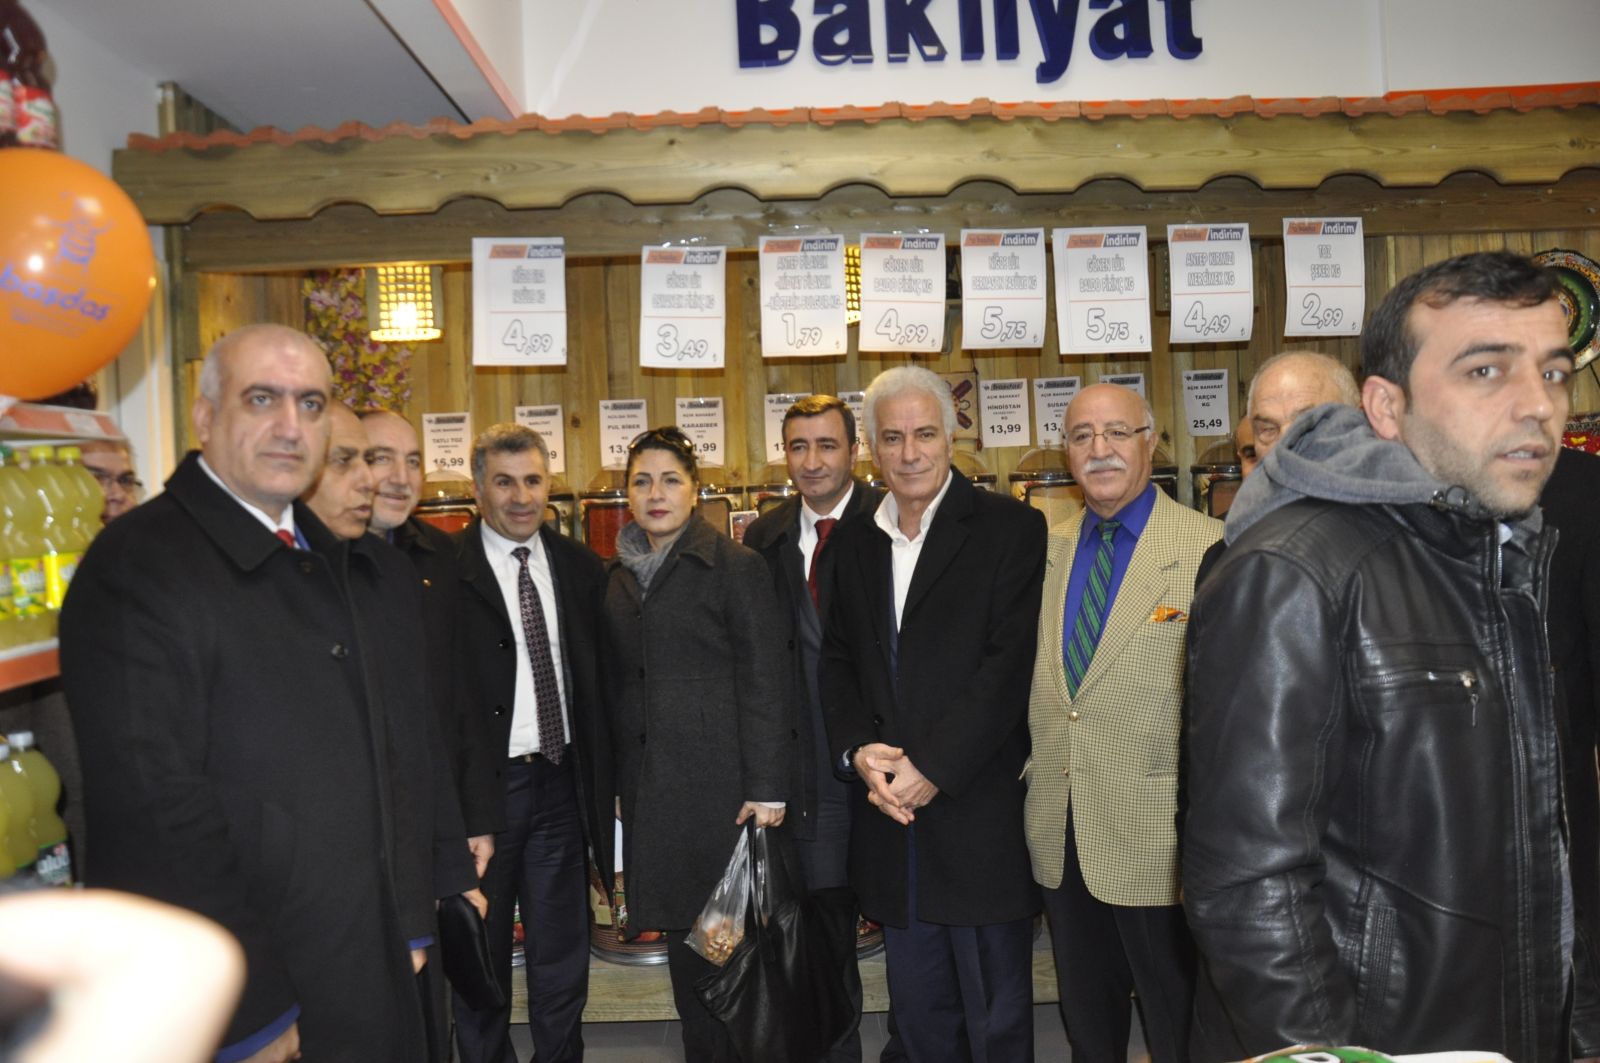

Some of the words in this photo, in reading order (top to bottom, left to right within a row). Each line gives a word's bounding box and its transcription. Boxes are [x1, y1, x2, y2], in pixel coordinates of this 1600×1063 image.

[1209, 228, 1242, 241] indirim
[1323, 222, 1355, 235] indirim
[803, 240, 836, 252] indirim
[903, 237, 937, 249] indirim
[1004, 234, 1037, 246] indirim
[1106, 233, 1138, 247] indirim
[1317, 243, 1332, 259] TOZ
[686, 252, 718, 265] indirim
[1185, 251, 1208, 267] ANTEP
[1208, 250, 1236, 266] KIRMIZI
[1187, 269, 1223, 287] MERCİMEK
[1223, 270, 1236, 287] KG
[1310, 263, 1330, 281] ŞEKER
[1330, 263, 1341, 279] KG
[1183, 300, 1232, 336] 4,49
[1301, 292, 1344, 330] 2,99
[781, 312, 823, 349] 1,79
[875, 308, 929, 345] 4,99
[980, 305, 1028, 342] 5,75
[1085, 307, 1130, 344] 5,75
[502, 318, 554, 356] 4,99
[656, 323, 709, 361] 3,49
[1194, 393, 1217, 401] TARÇIN
[987, 403, 1021, 411] HİNDİSTAN
[989, 423, 1022, 435] 13,99
[1043, 422, 1062, 433] 13,
[1192, 418, 1223, 430] 25,49
[608, 444, 630, 455] 13,
